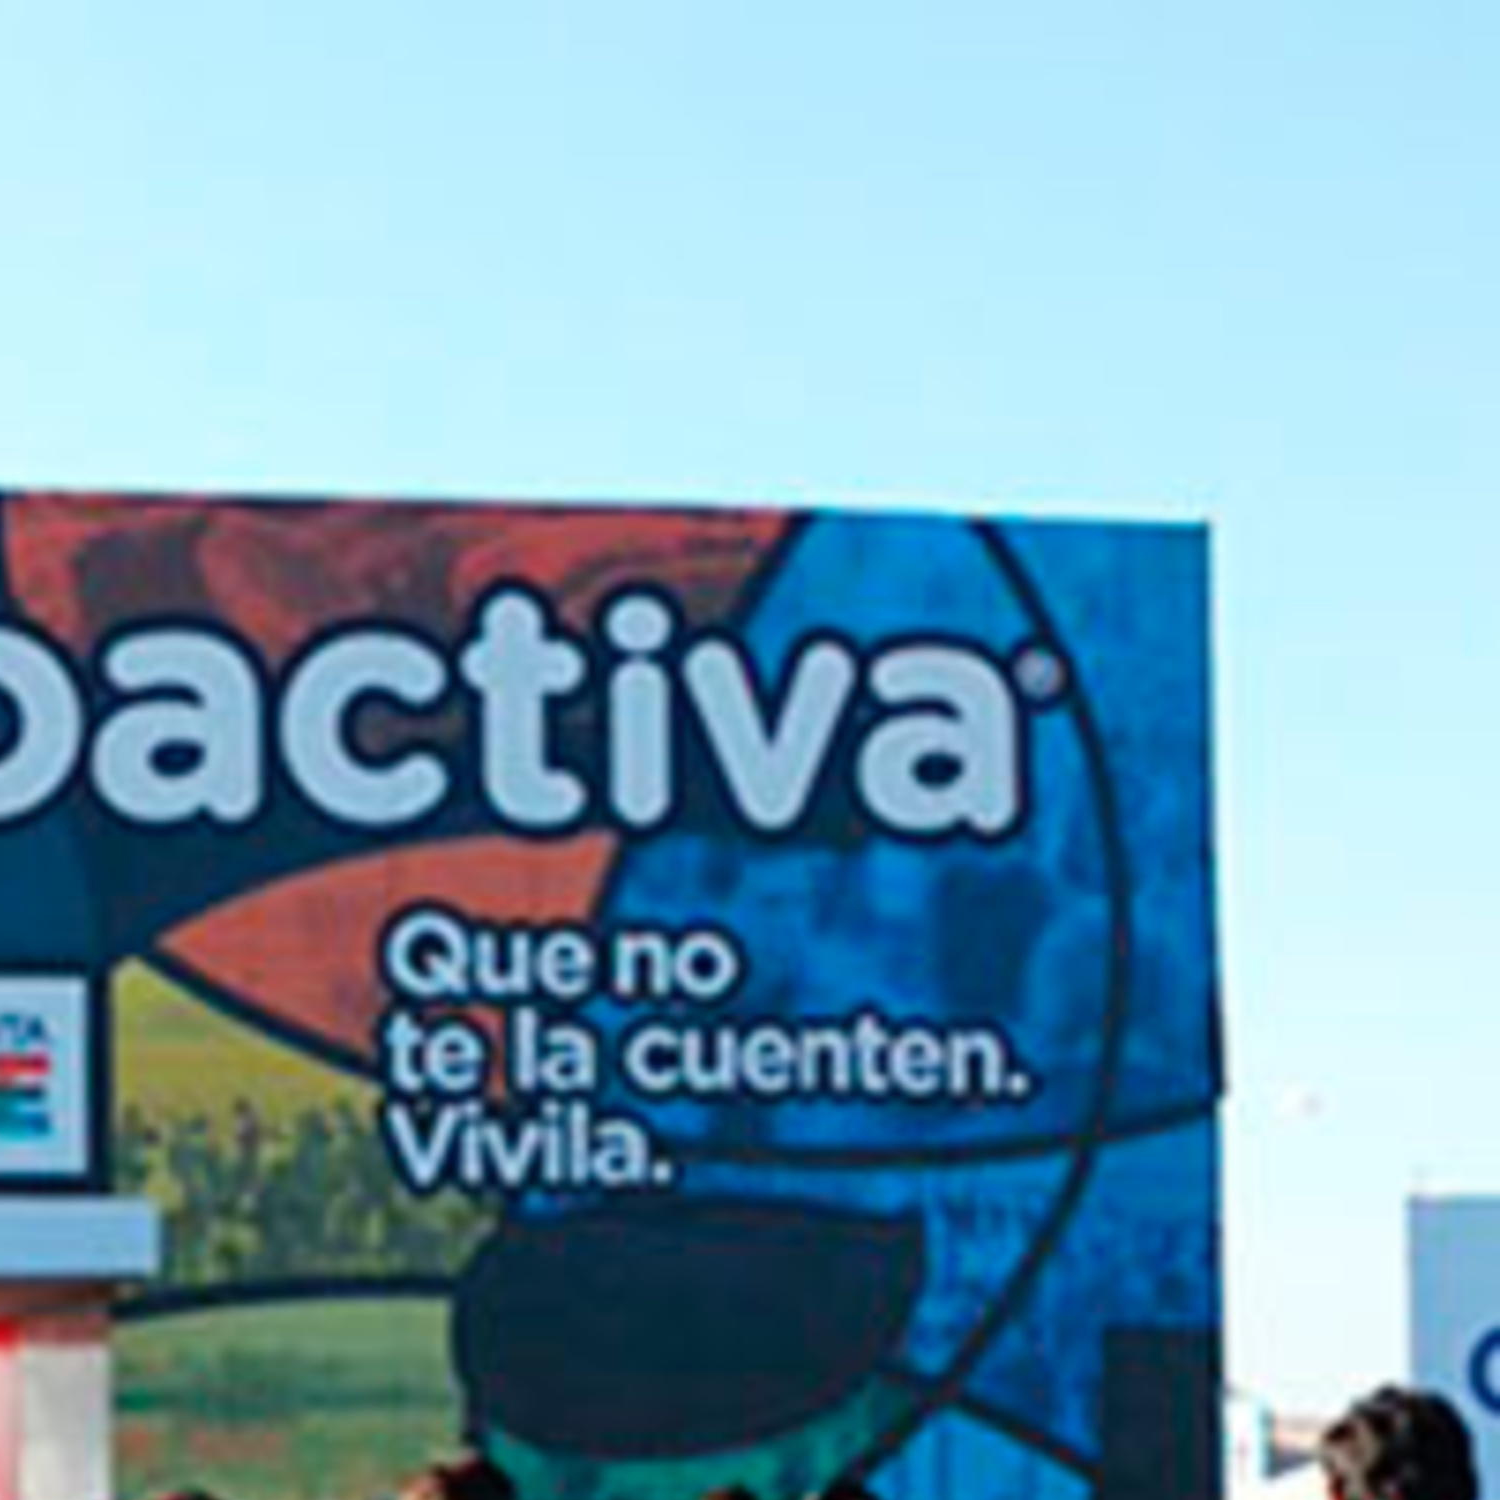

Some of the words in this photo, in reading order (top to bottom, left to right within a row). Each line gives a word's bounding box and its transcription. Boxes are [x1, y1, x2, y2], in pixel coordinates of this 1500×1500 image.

[386, 909, 594, 995] Que
[613, 929, 738, 995] no
[385, 1012, 486, 1092] te
[512, 1006, 596, 1092] la
[622, 1012, 1032, 1096] cuenten.
[386, 1100, 674, 1185] Vivila.
